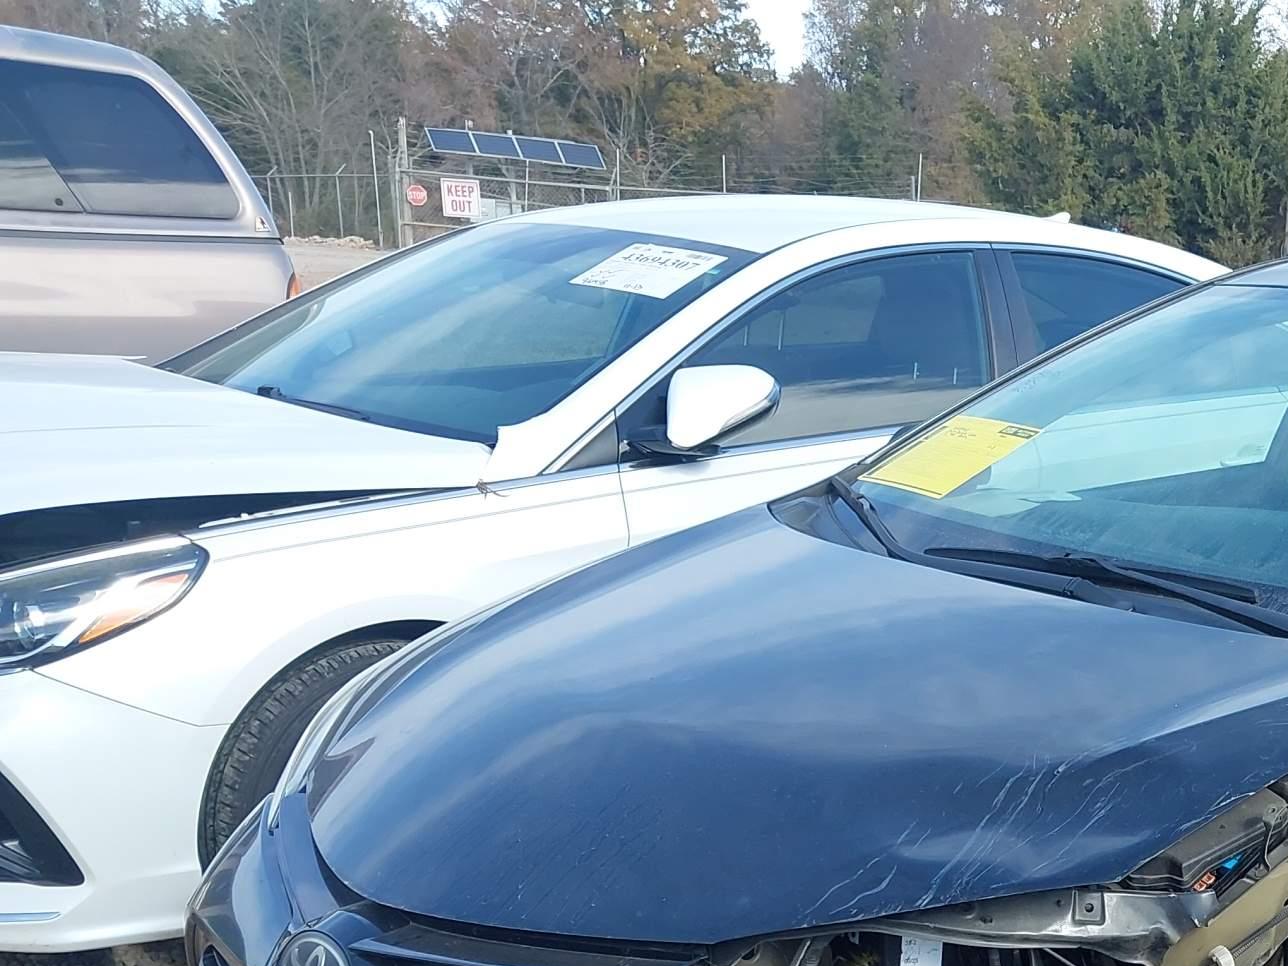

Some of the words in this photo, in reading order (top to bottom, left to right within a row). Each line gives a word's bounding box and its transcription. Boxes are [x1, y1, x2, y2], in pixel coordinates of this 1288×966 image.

[408, 191, 427, 200] STOP
[446, 184, 474, 198] KEEP
[450, 200, 472, 213] OUT
